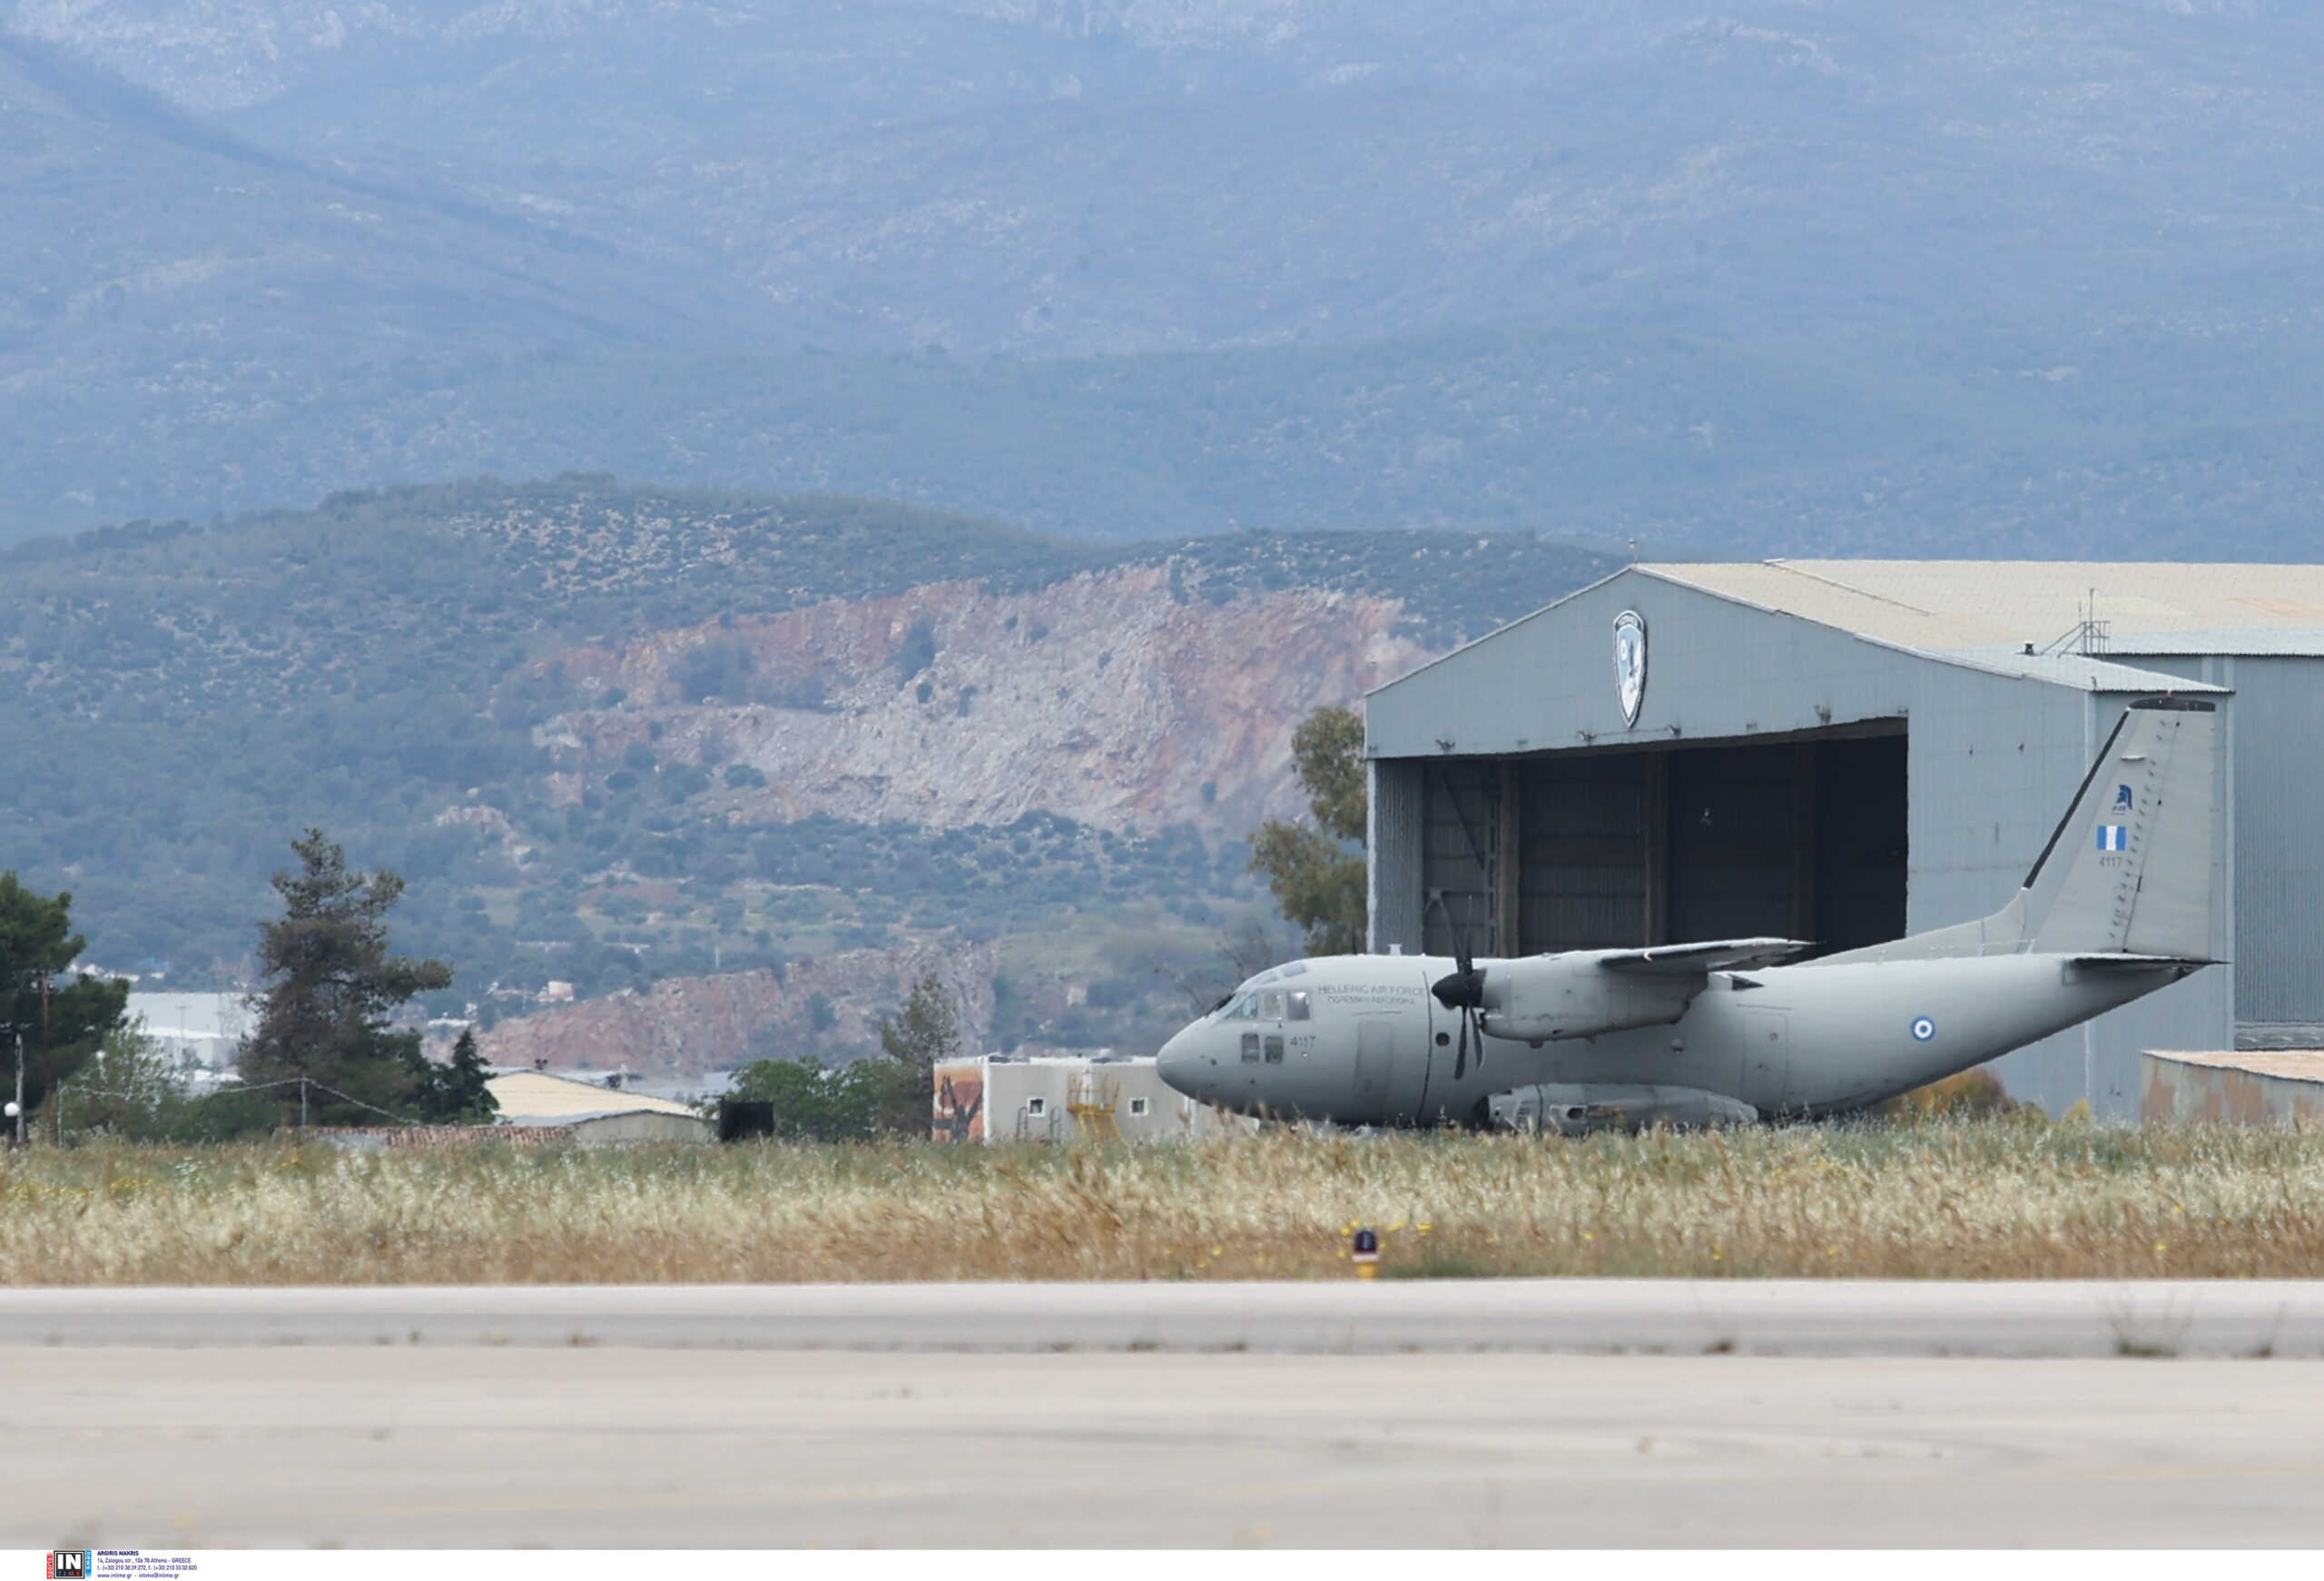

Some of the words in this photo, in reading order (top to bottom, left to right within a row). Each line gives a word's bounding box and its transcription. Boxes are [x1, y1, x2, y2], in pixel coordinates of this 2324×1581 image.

[2100, 856, 2122, 867] 4117
[1318, 984, 1368, 995] HELLENIC
[1371, 985, 1387, 995] AIR
[1389, 986, 1424, 997] FORCE
[1290, 1035, 1315, 1047] 4117
